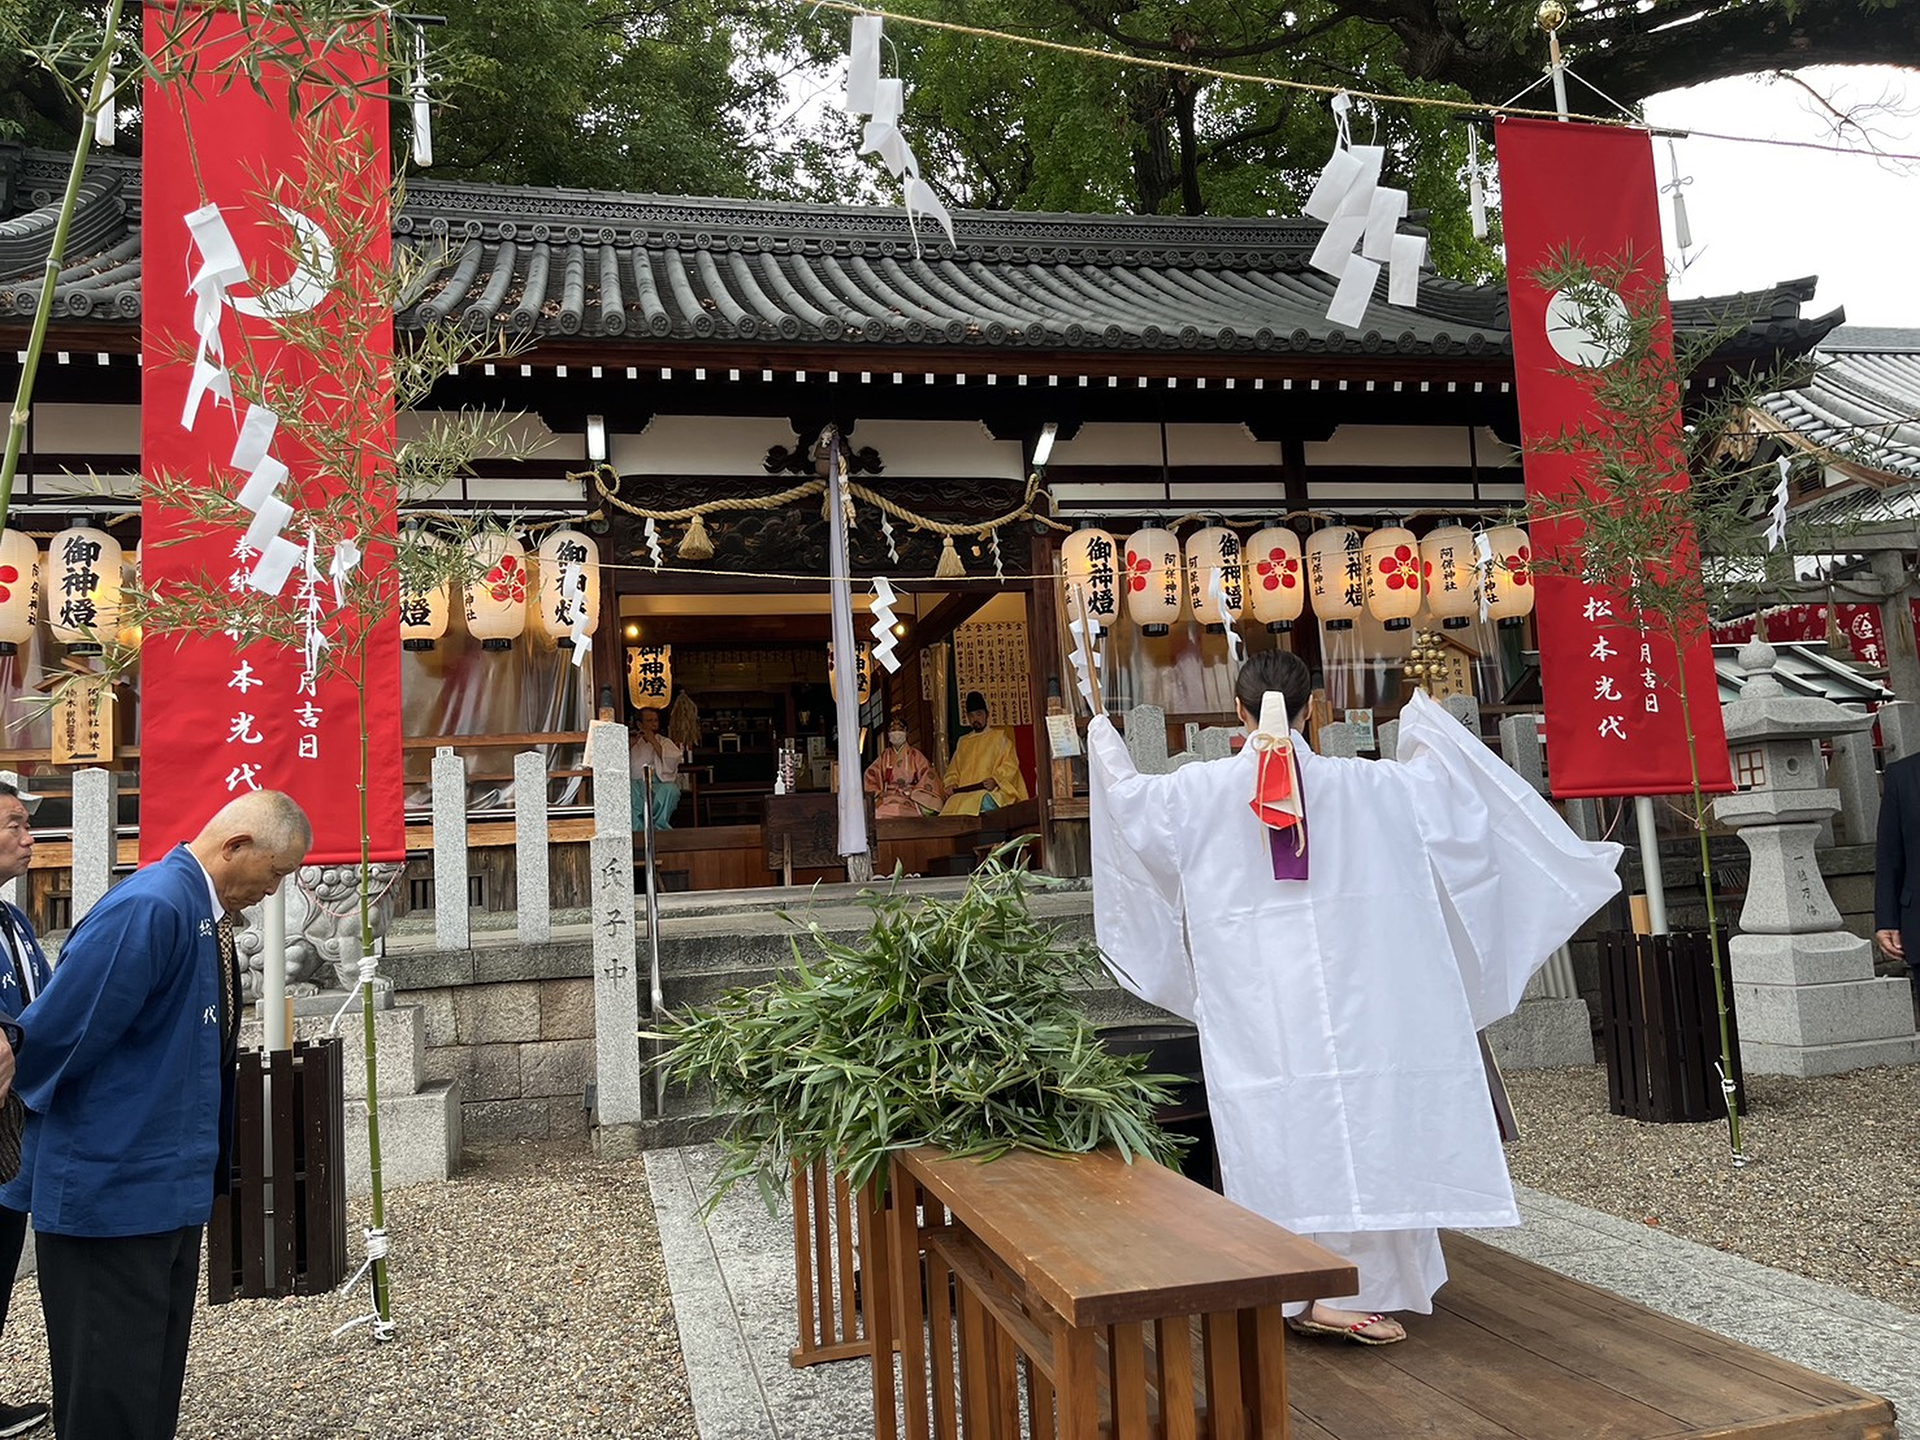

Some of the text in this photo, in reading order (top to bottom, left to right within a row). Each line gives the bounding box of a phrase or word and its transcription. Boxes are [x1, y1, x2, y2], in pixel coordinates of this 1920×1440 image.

[60, 535, 102, 628] 御神燈
[1086, 536, 1115, 615] 御神燈
[1440, 547, 1458, 592] 阿保神社
[1484, 557, 1499, 604] 保神社
[1583, 597, 1627, 740] 松本光代
[601, 857, 629, 991] 氏子中
